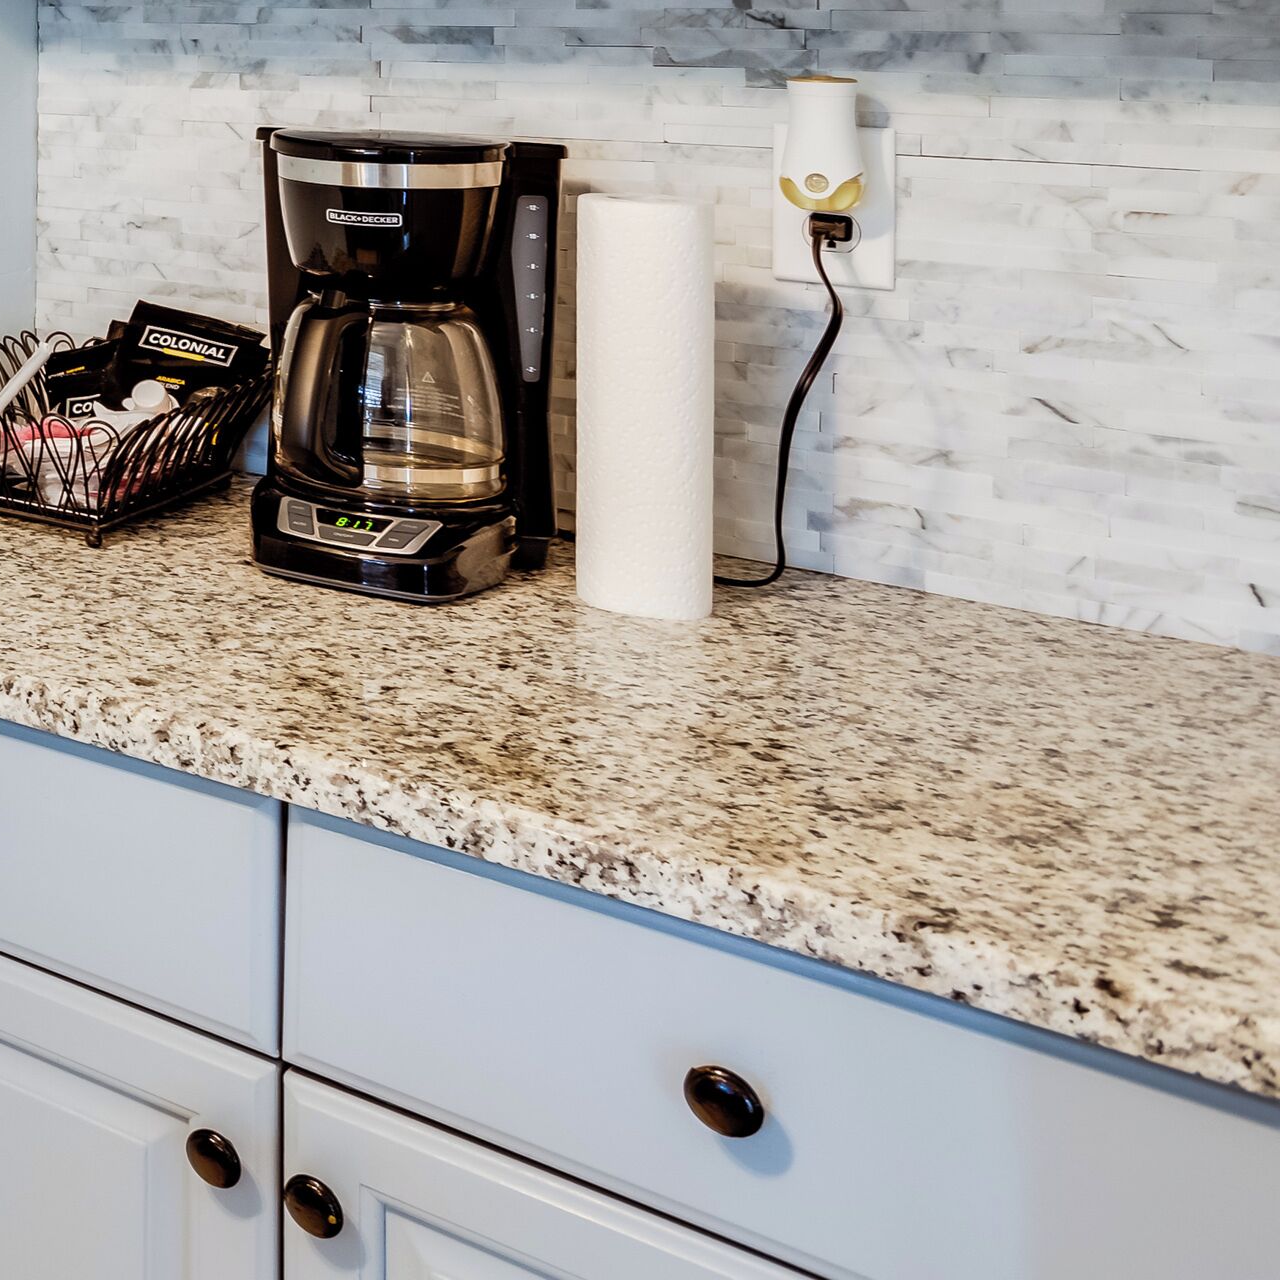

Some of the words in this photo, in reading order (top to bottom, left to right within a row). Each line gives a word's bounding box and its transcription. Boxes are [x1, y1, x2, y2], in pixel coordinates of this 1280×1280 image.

[148, 332, 227, 359] COLONIAL
[155, 375, 186, 386] ARABICA
[335, 517, 373, 531] 8:17
